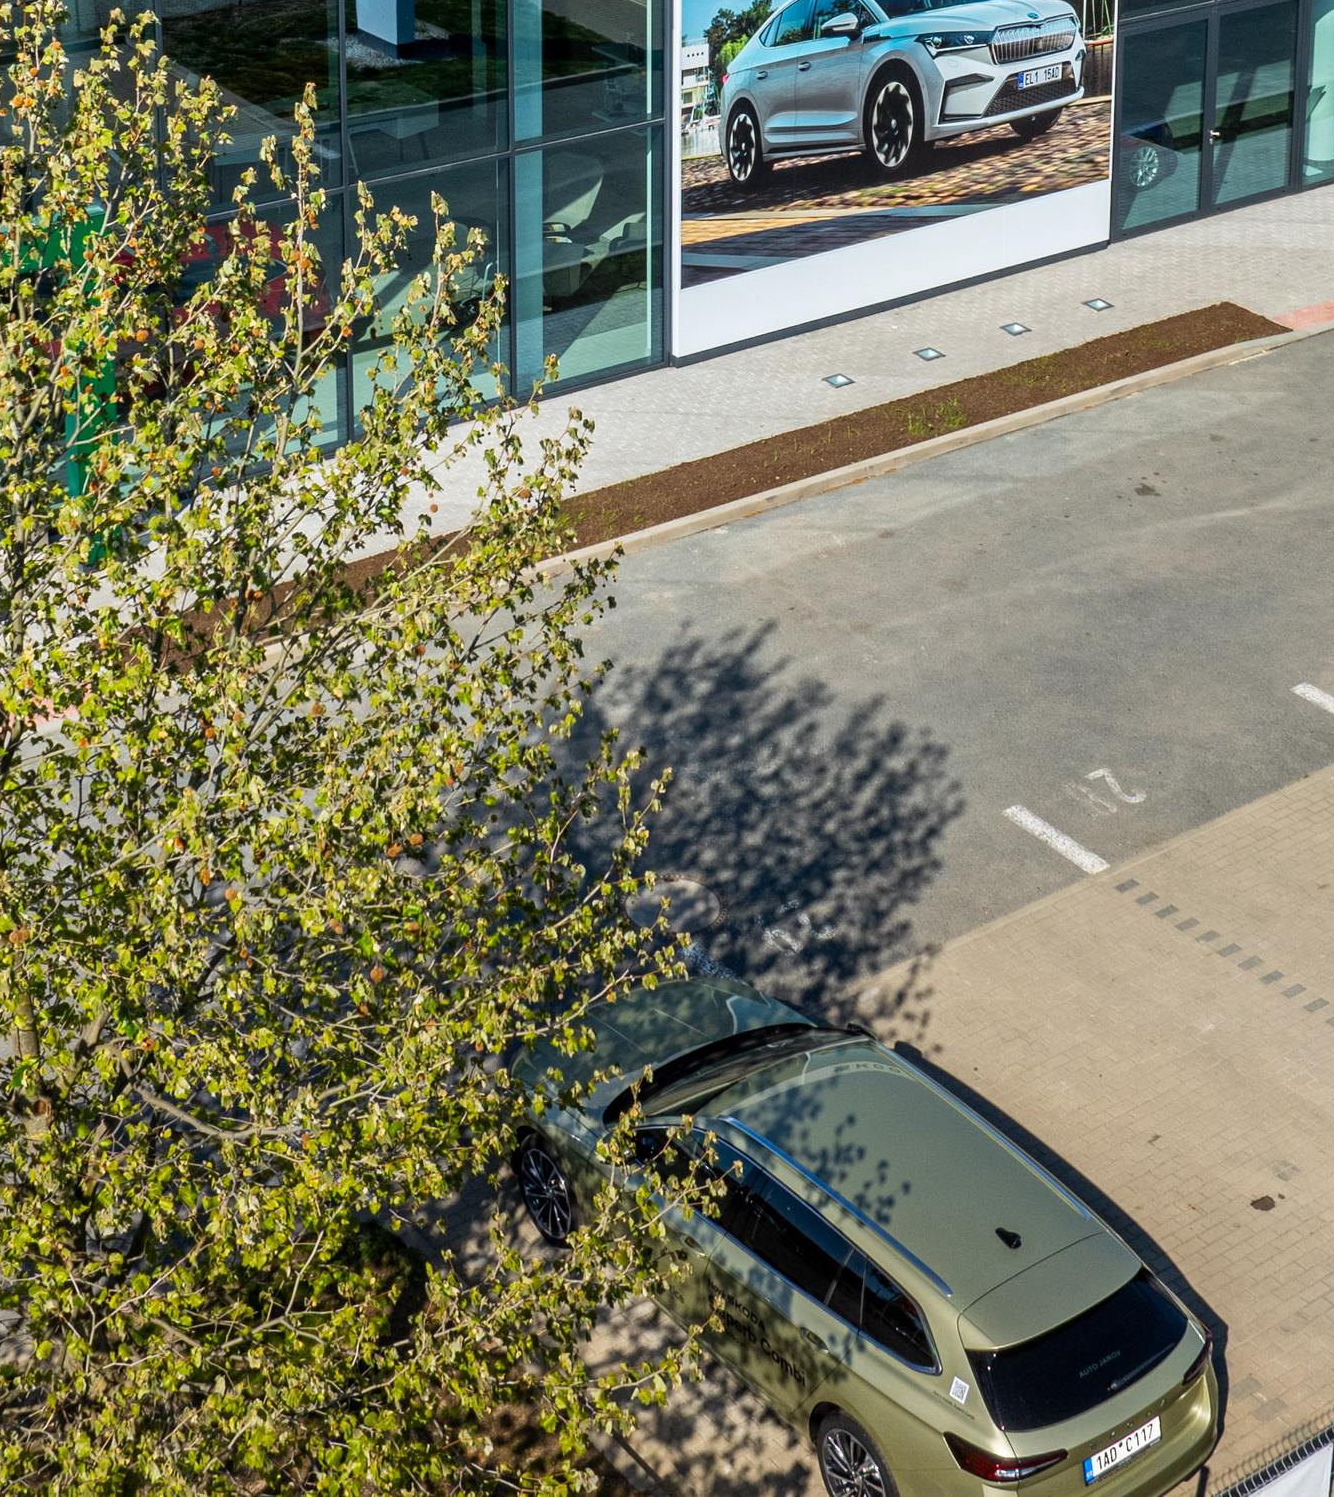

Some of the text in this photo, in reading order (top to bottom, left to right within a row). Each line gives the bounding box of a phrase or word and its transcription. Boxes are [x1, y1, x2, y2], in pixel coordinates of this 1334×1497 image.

[760, 1338, 805, 1386] Combi
[1096, 1446, 1117, 1470] 1AD
[1125, 1423, 1154, 1452] C117
